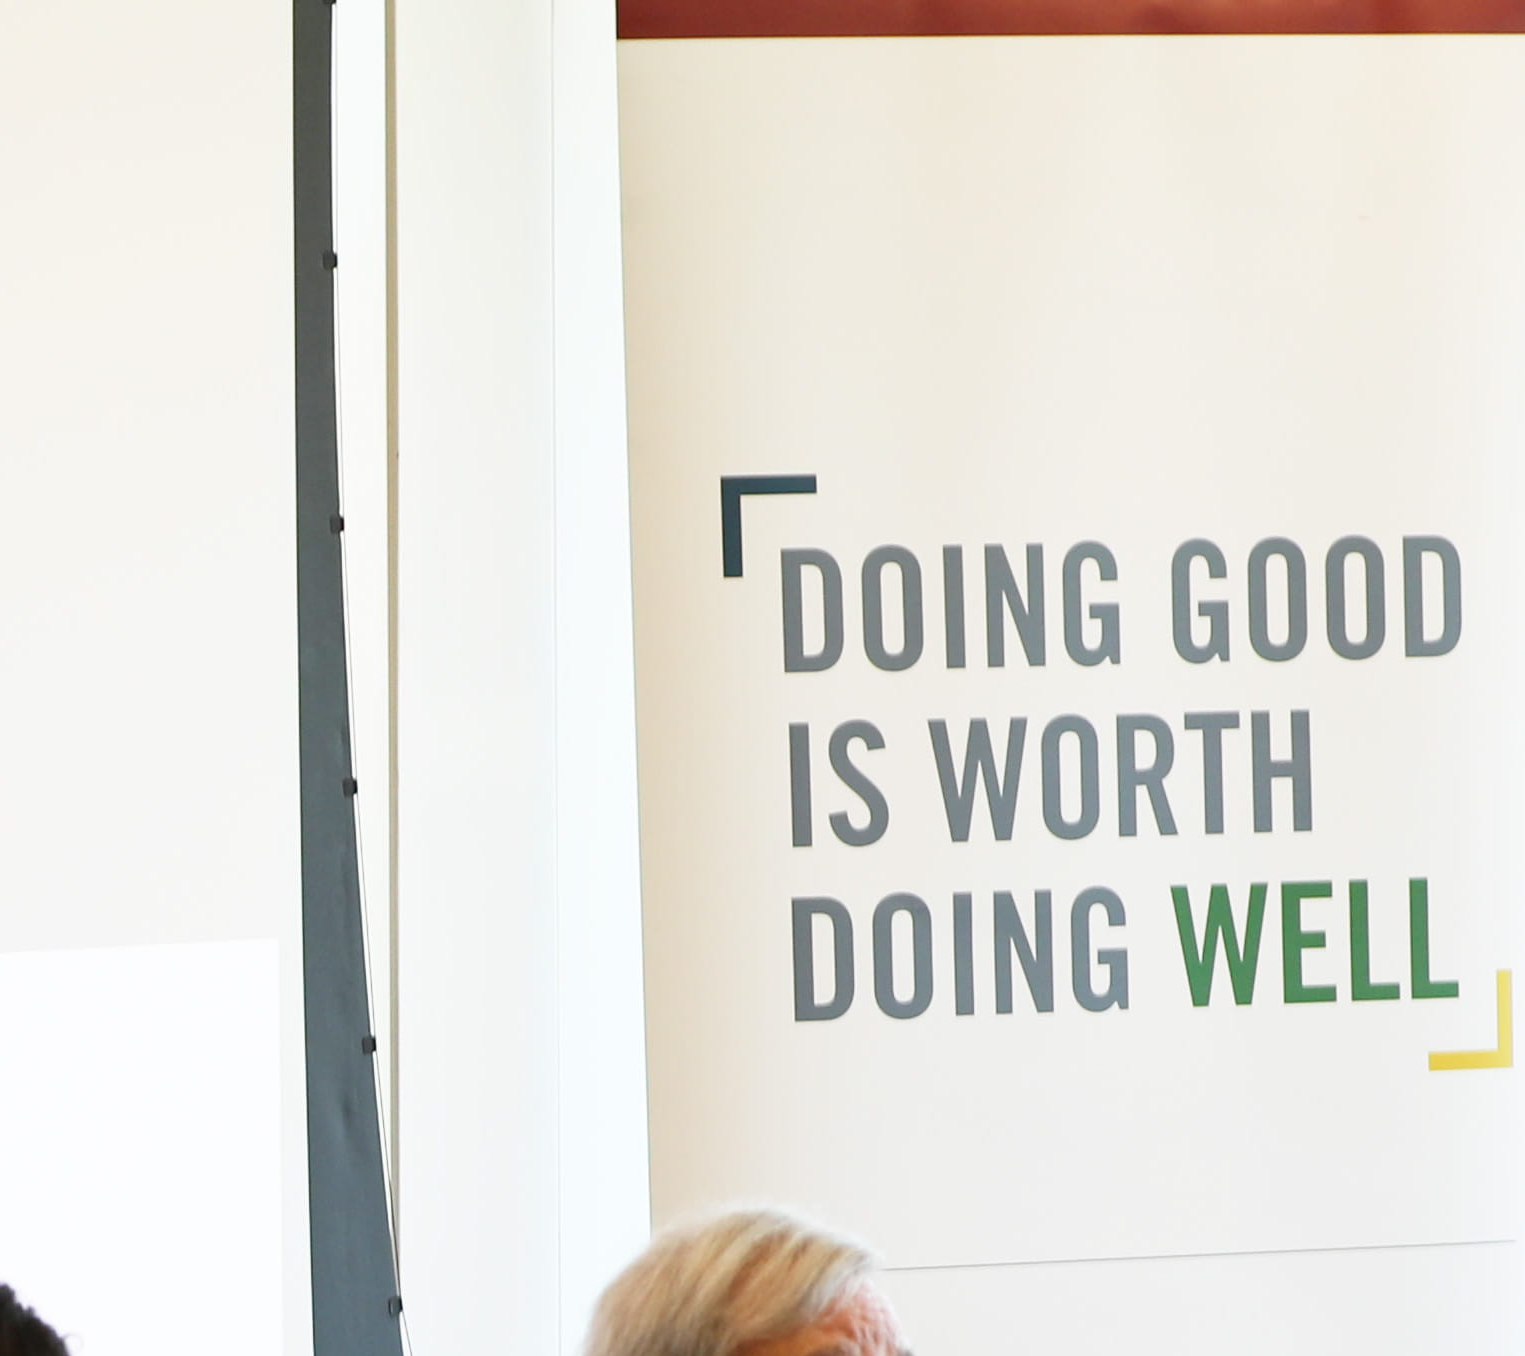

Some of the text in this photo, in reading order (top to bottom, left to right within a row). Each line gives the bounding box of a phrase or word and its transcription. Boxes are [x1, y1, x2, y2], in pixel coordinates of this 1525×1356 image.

[780, 535, 1463, 674] DOING GOOD
[788, 709, 1313, 849] IS WORTH
[790, 877, 1460, 1023] DOING WELL
